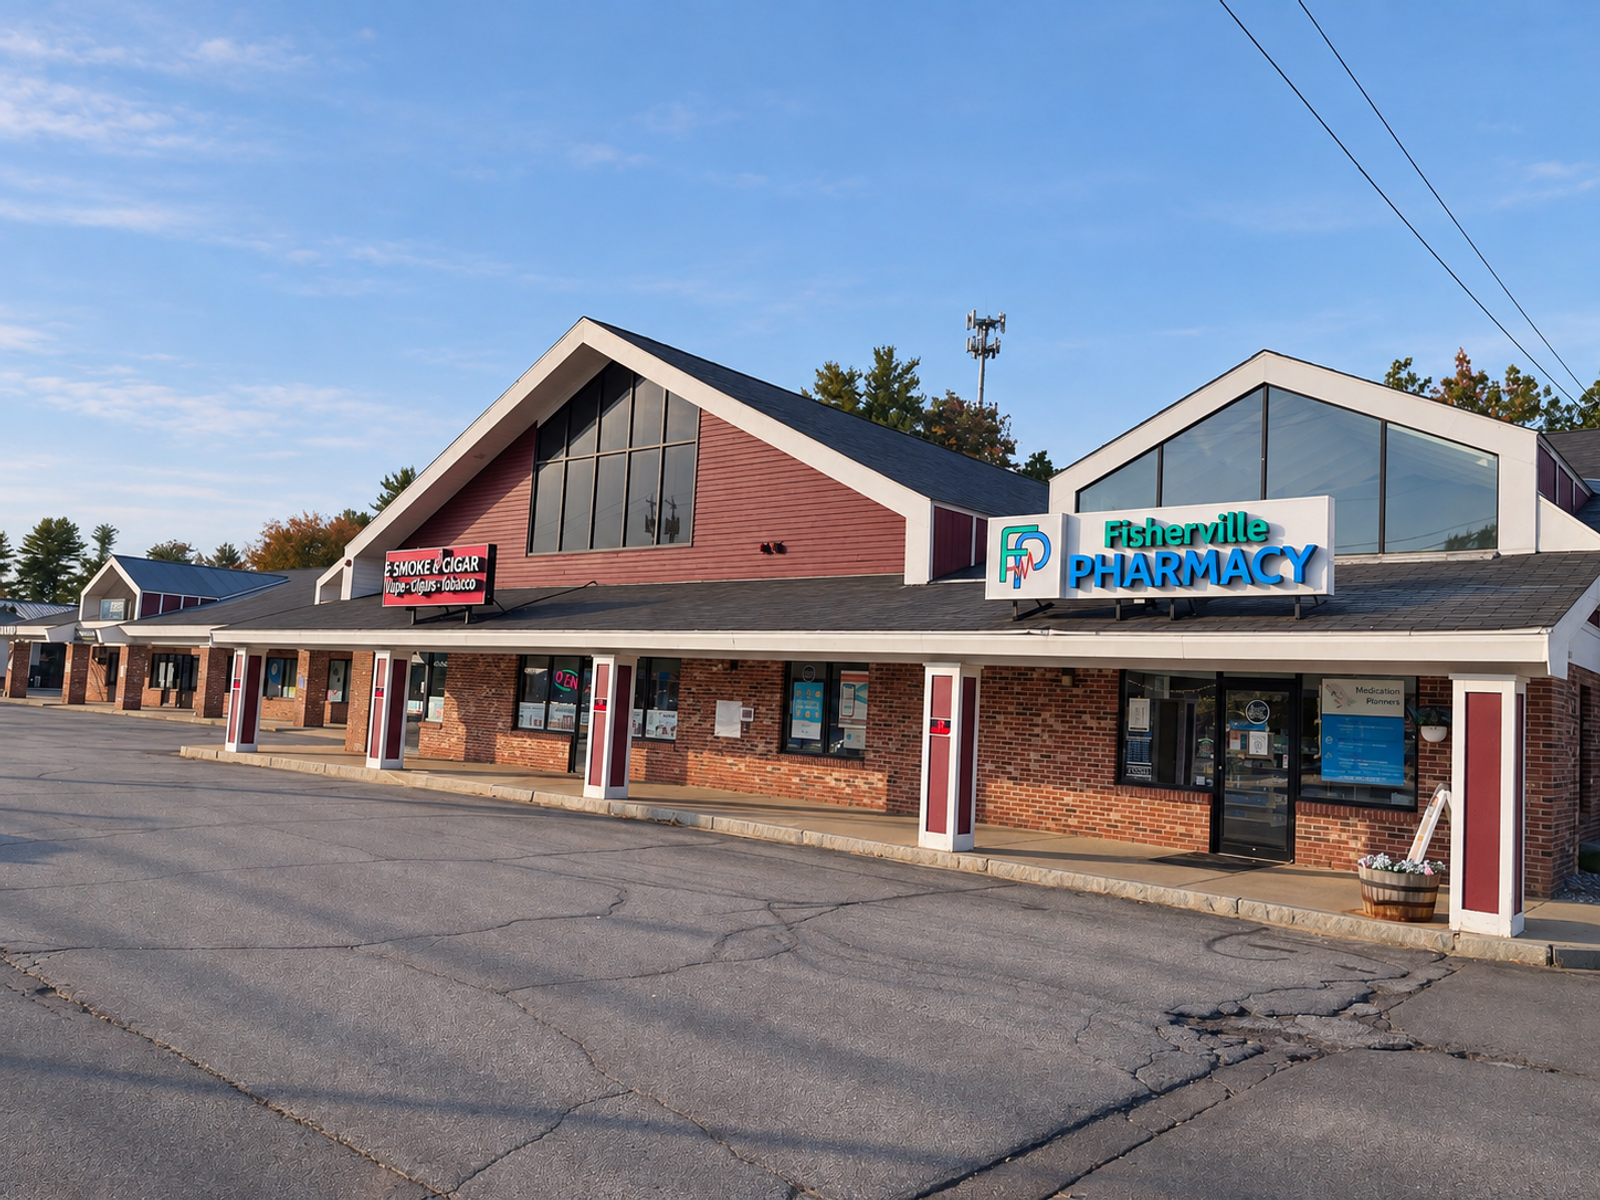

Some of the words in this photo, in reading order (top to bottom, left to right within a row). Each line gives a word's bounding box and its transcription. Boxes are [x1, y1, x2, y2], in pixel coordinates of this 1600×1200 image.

[1104, 511, 1269, 549] Fisherville
[393, 559, 431, 577] SMOKE
[442, 555, 479, 574] CIGAR
[1069, 544, 1318, 589] PHARMACY
[1355, 686, 1401, 696] Medication
[1366, 697, 1401, 706] Planners
